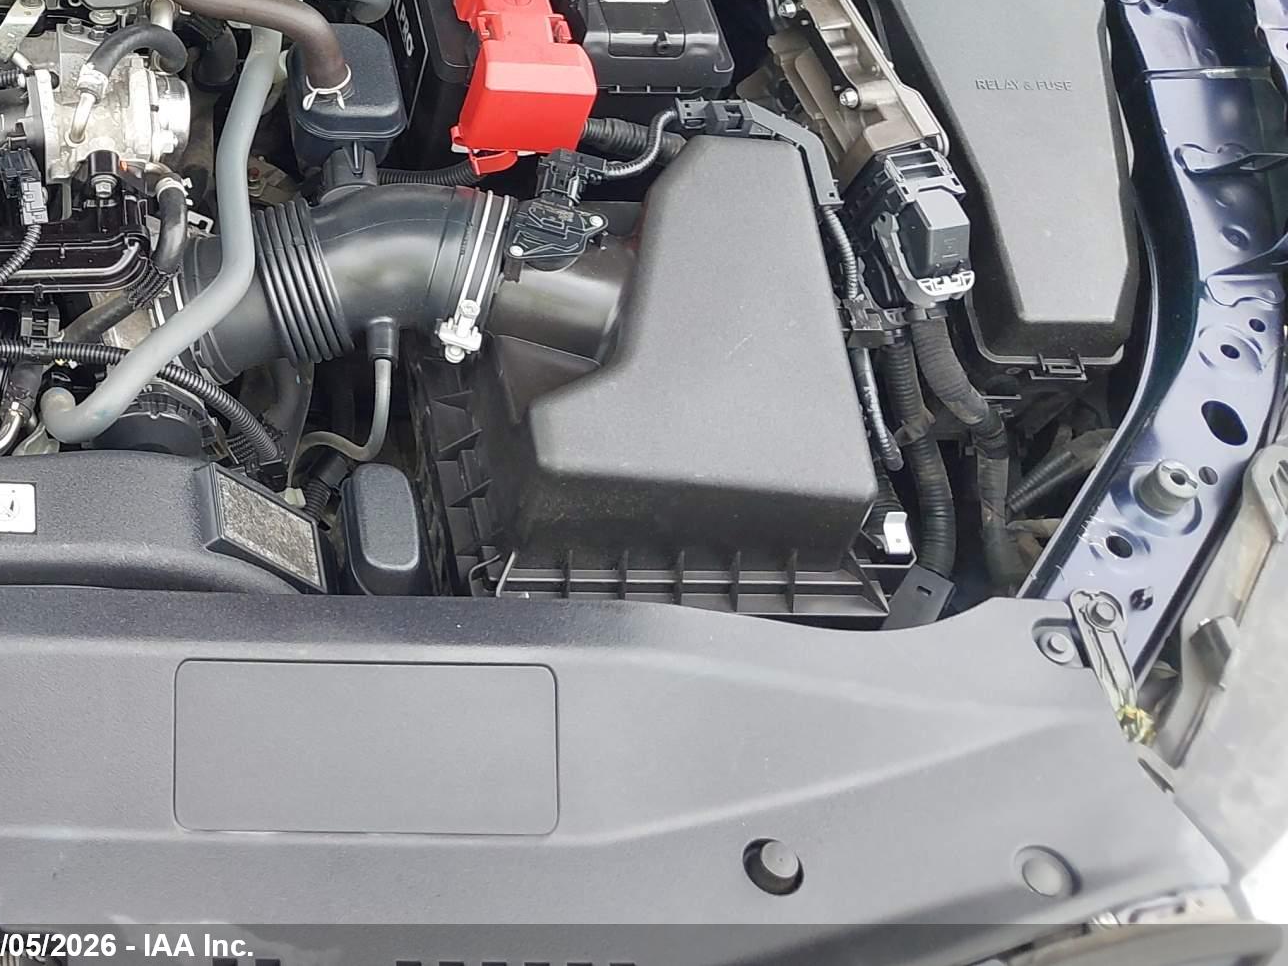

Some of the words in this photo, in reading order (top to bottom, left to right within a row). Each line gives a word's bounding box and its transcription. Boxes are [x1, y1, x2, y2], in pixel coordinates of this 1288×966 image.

[975, 79, 1019, 91] RELAY
[1023, 81, 1034, 91] &
[1036, 81, 1073, 92] FUSE
